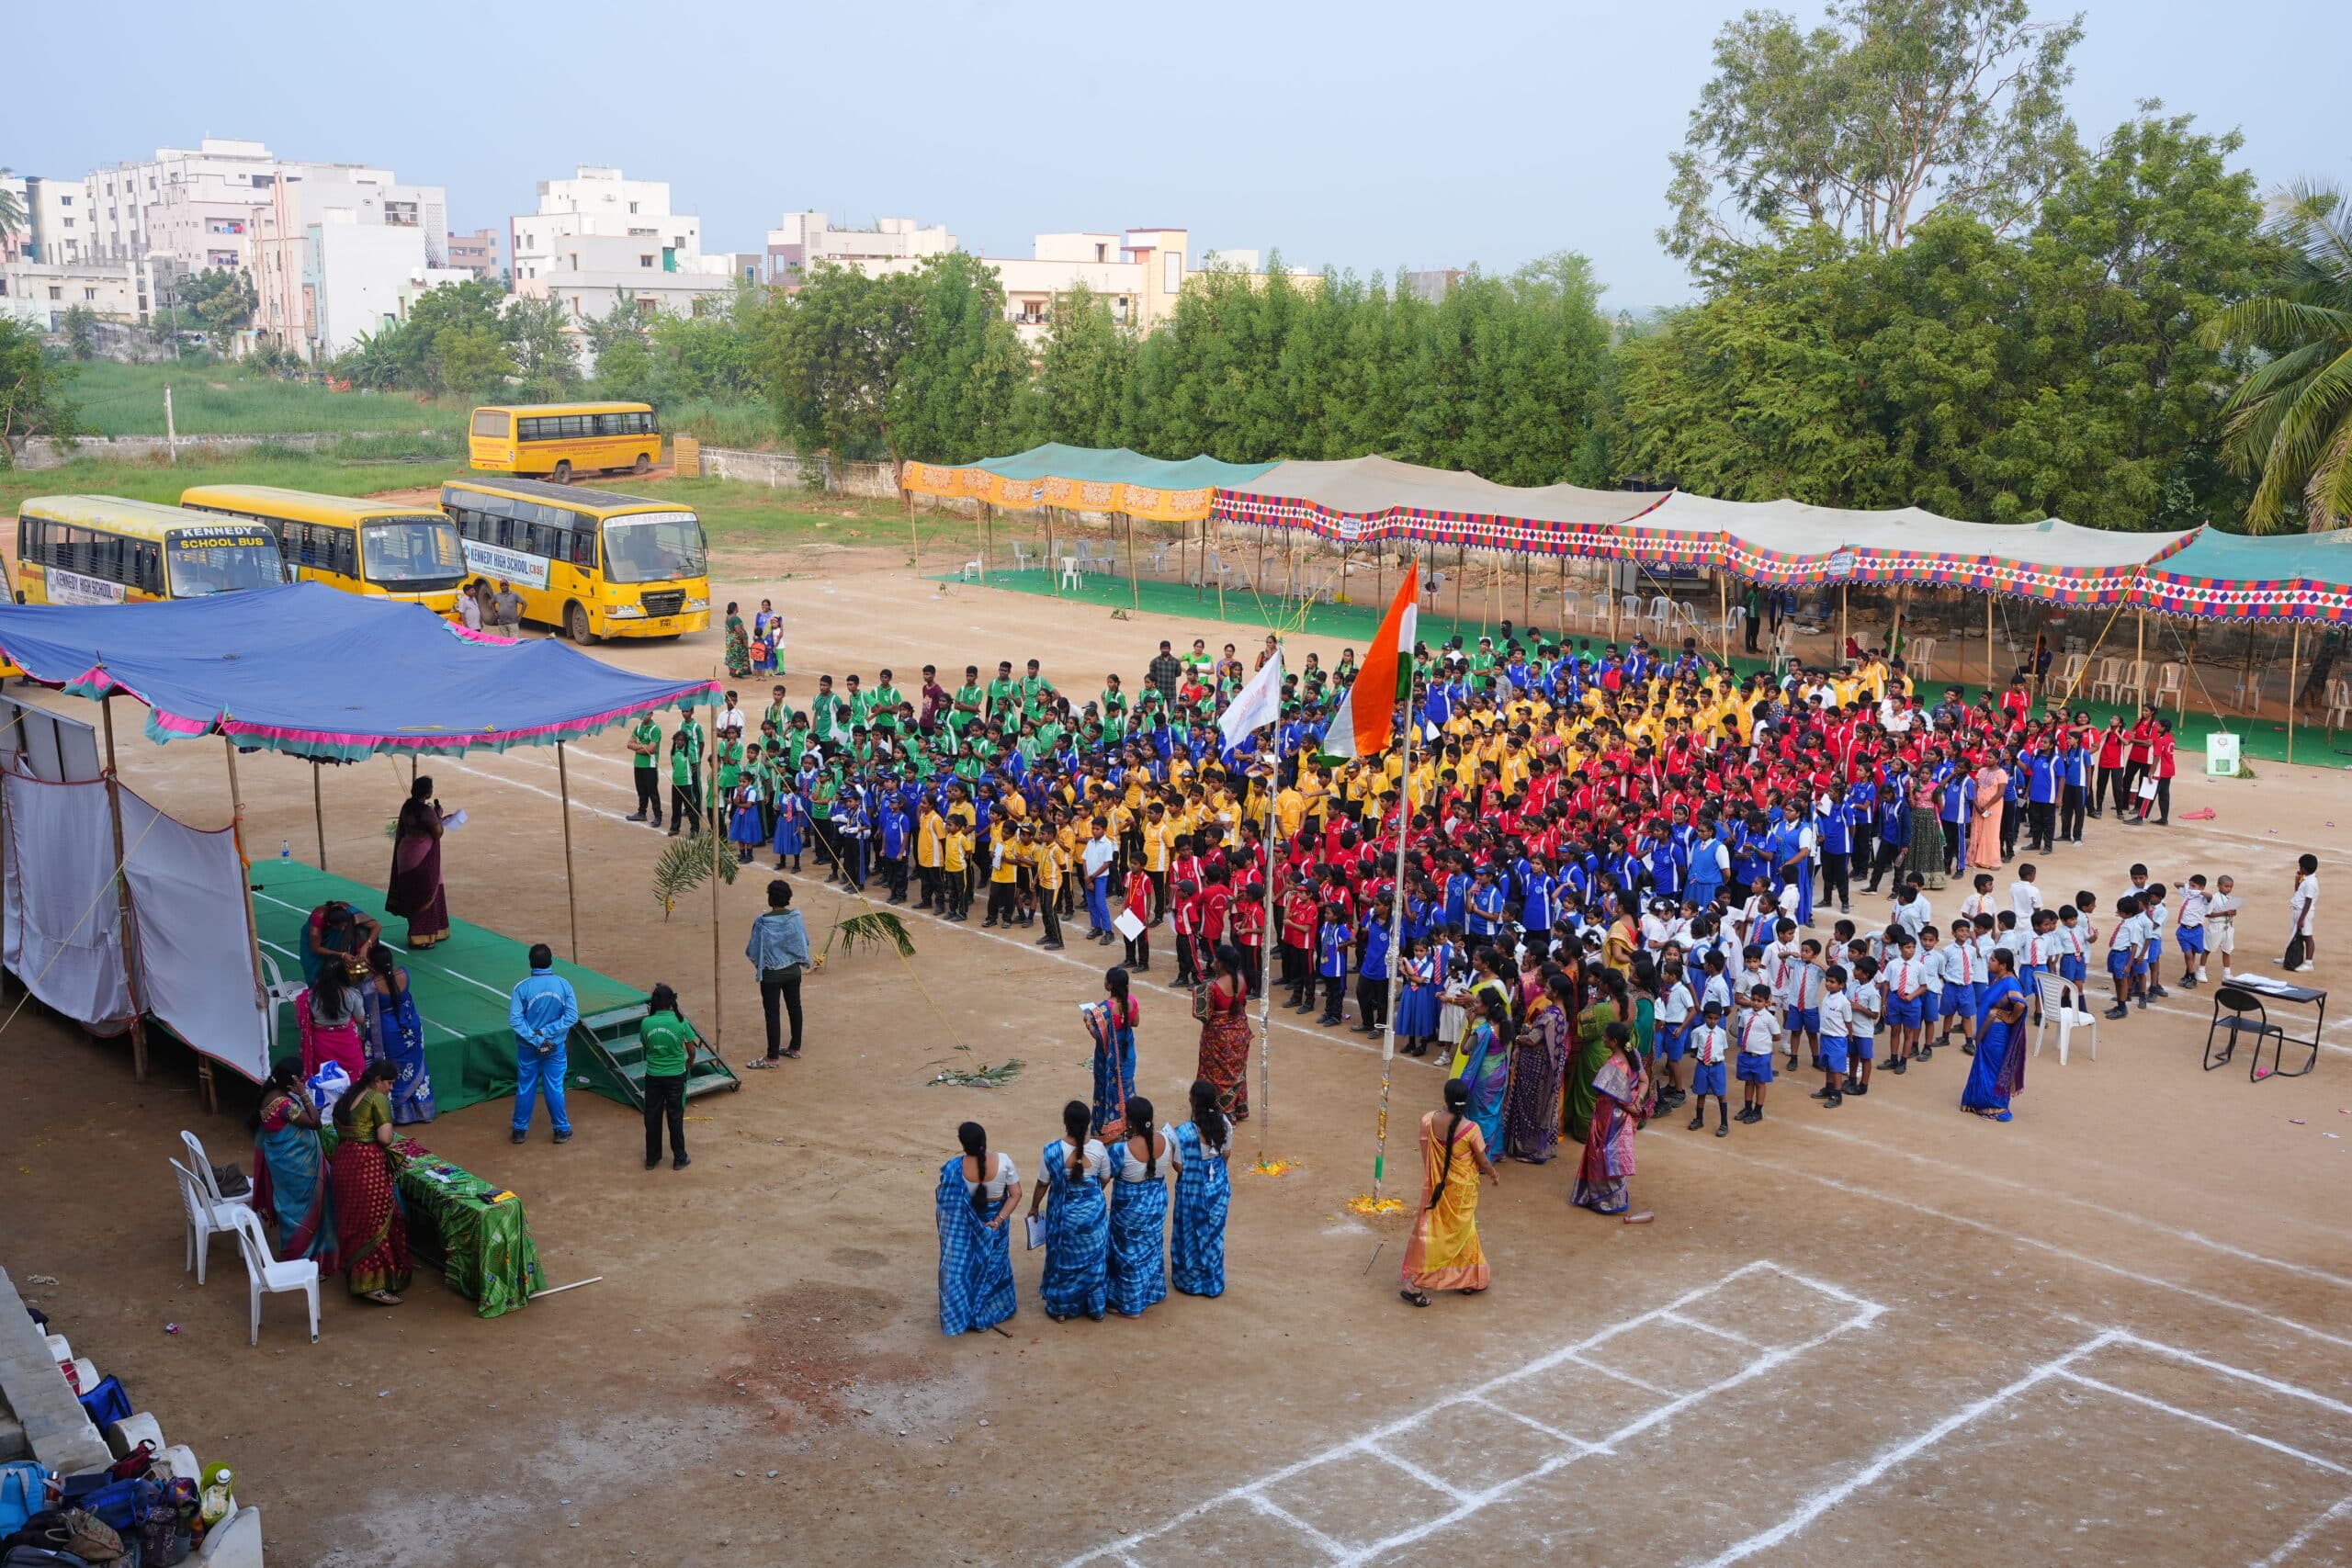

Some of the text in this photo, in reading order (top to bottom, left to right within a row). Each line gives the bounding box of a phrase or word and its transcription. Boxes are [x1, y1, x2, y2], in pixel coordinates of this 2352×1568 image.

[181, 526, 253, 537] KENNEDY
[180, 537, 265, 549] SCHOOL BUS
[470, 547, 493, 566] KENNEDY
[493, 552, 506, 569] HIGH
[507, 557, 528, 575] SCHOOL
[56, 572, 79, 590] KENNEDY
[79, 577, 91, 593] HIGH
[92, 581, 113, 599] SCHOOL
